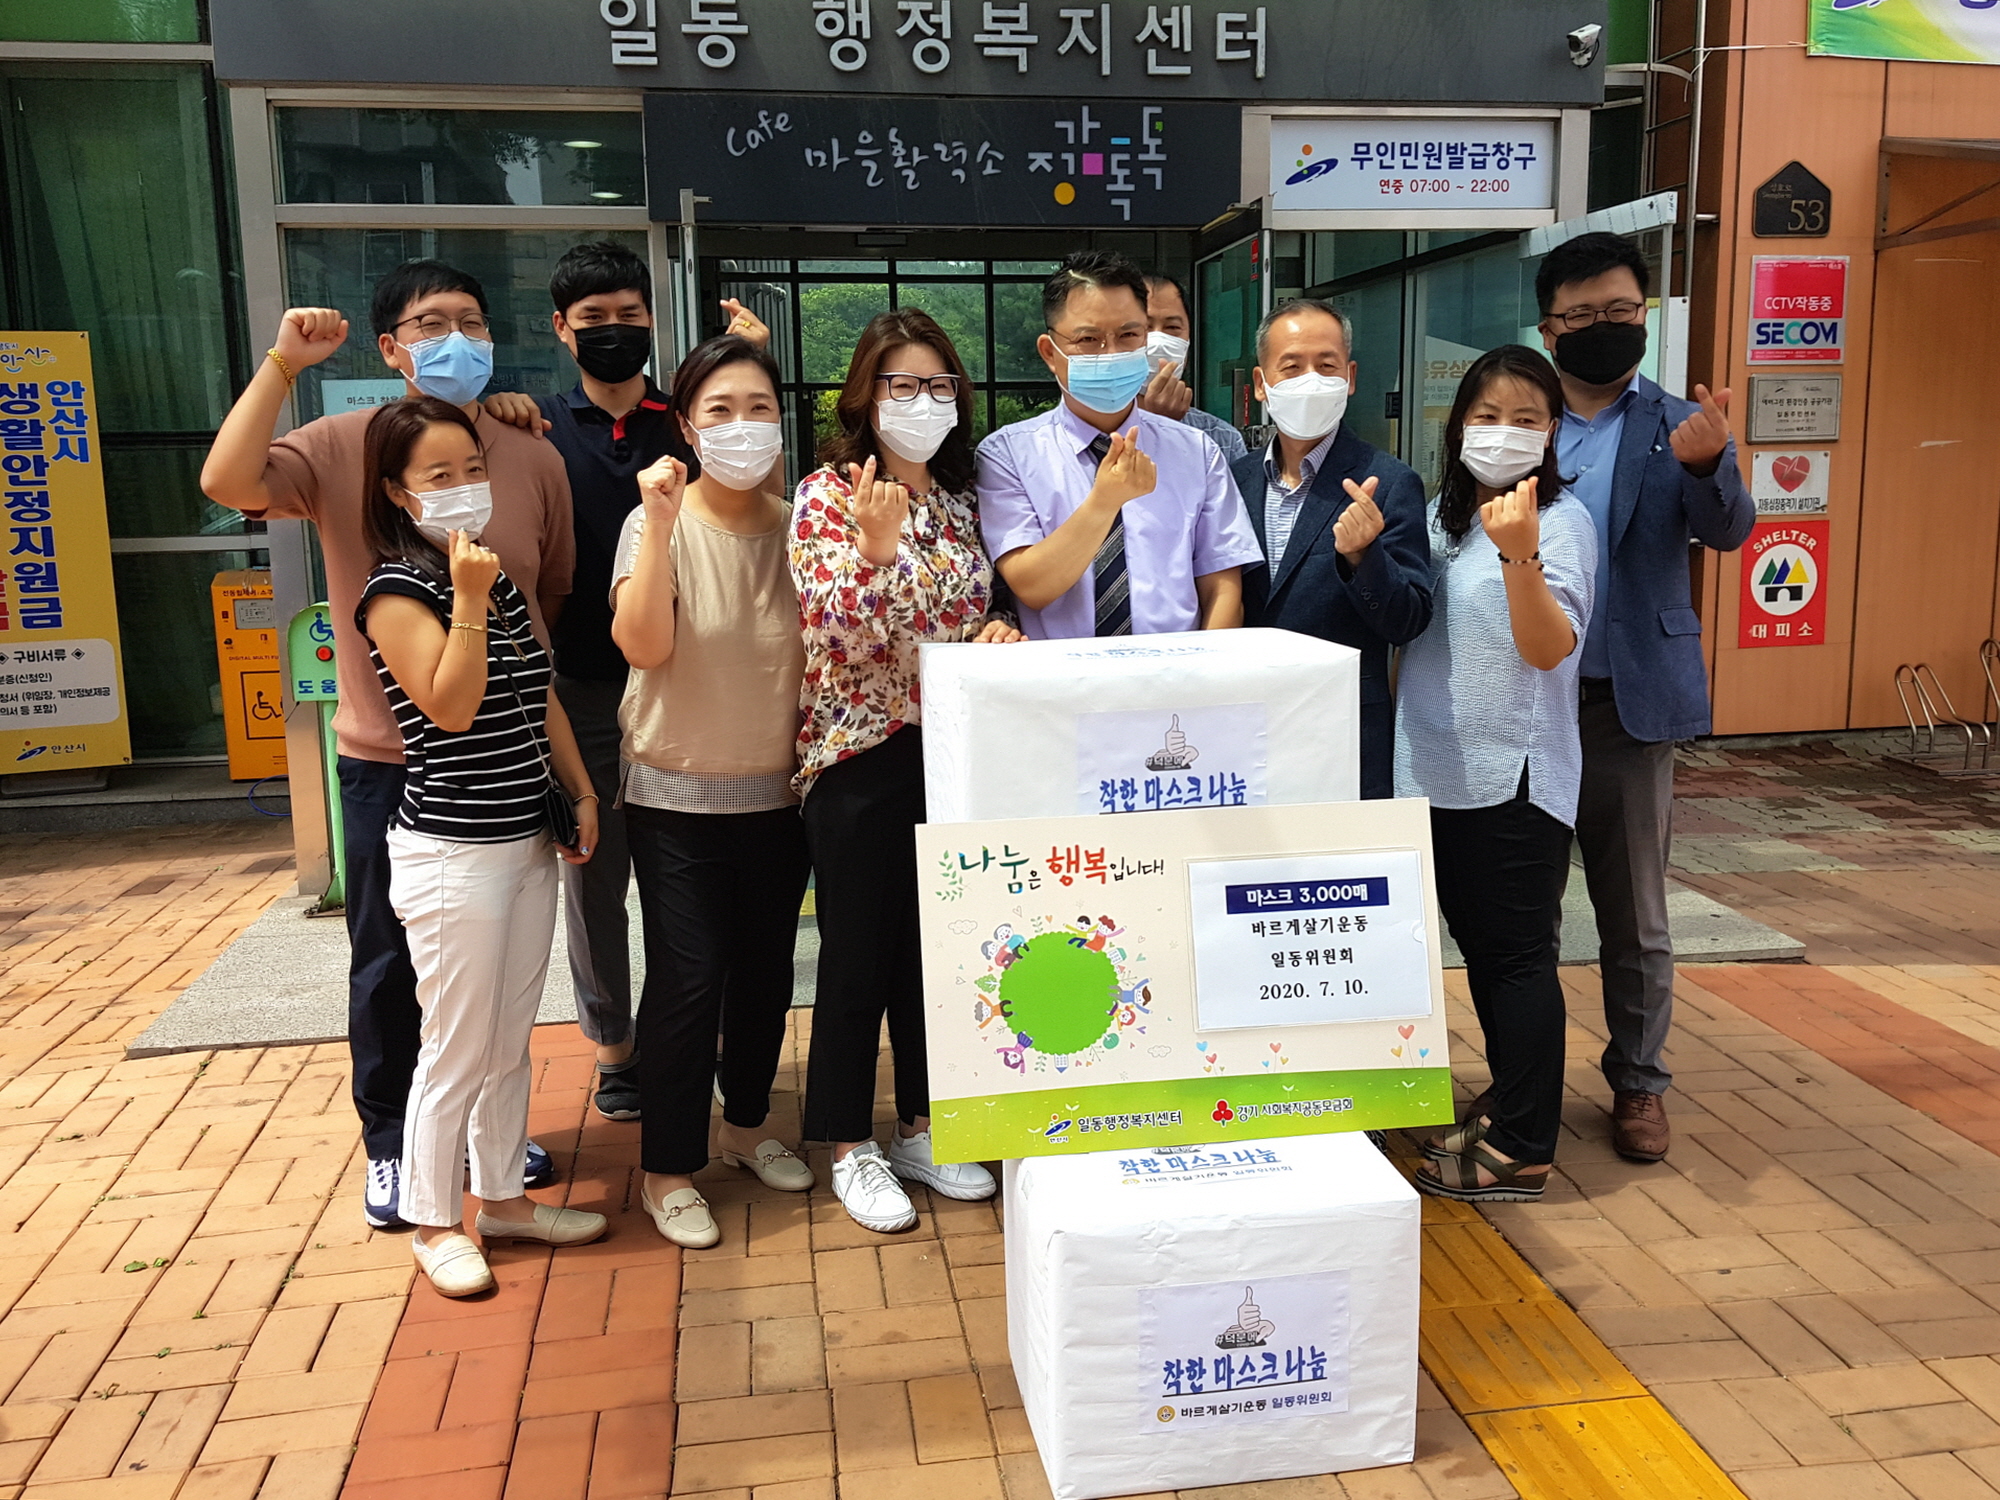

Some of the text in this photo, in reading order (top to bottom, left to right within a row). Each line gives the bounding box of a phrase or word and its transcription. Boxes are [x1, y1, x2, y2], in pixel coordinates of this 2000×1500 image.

[600, 0, 1267, 78] 일동 행정복지센터
[726, 109, 793, 157] Cafe
[804, 127, 1005, 191] 마을활력소
[1350, 141, 1537, 171] 무인민원발급창구
[1379, 178, 1404, 195] 연중
[1409, 178, 1451, 194] 07:00
[1470, 178, 1510, 194] 22:00
[1787, 199, 1824, 231] 53
[1764, 296, 1833, 312] CCTV작동중
[1756, 321, 1838, 345] SECOM
[346, 396, 376, 406] 마스크
[46, 380, 89, 463] 안산시
[1753, 530, 1817, 553] SHELTER
[1751, 622, 1813, 639] 대피소
[13, 649, 67, 664] 구비서류
[57, 687, 110, 699] 개인정보제공
[298, 679, 337, 694] 도움
[33, 703, 58, 714] 포함)
[51, 743, 86, 755] 안산시
[1099, 772, 1247, 813] 착한 마스크 나눔
[958, 844, 1164, 894] 나눔은 행복입니다!
[1245, 884, 1368, 907] 마스크 3,000매
[1251, 915, 1369, 938] 바르게살기운동
[1271, 947, 1353, 968] 일동위원회
[1259, 979, 1369, 1001] 2020. 7. 10.
[1236, 1097, 1353, 1122] 경기 사회복지공동모금회
[1077, 1110, 1183, 1133] 일동행정복지센터
[1118, 1148, 1277, 1175] 착한 마스크 나눔
[1162, 1345, 1328, 1395] 착한 마스크 나눔
[1180, 1391, 1332, 1419] 바르게살기운동 일동위원회
